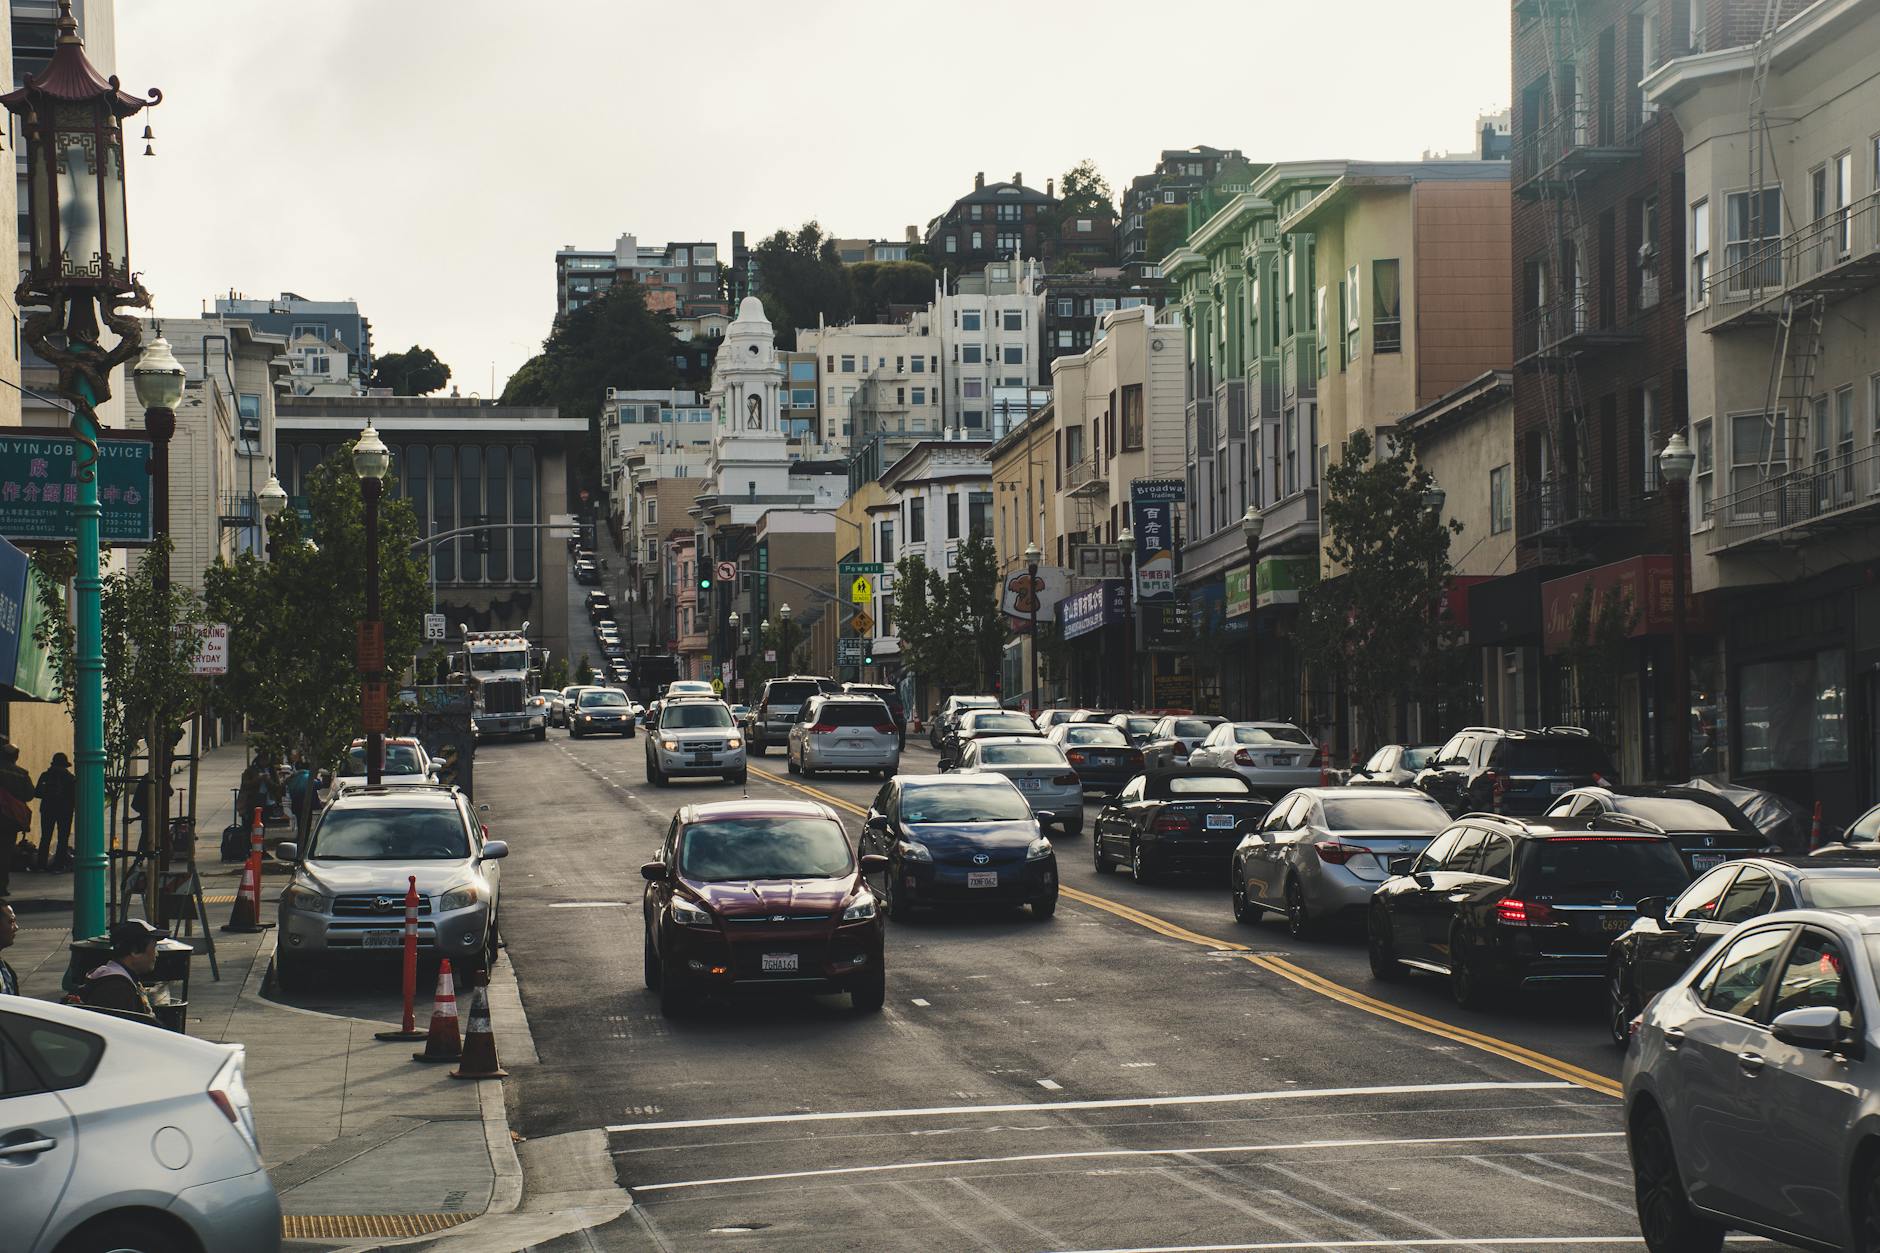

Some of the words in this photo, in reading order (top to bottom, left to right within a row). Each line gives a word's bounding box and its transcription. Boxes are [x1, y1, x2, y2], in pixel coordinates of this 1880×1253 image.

[13, 443, 38, 455] YIN
[43, 444, 73, 456] JOB
[98, 446, 143, 458] RVICE
[2, 480, 142, 505] 作介紹服中心
[1151, 492, 1176, 500] Trading
[1143, 507, 1161, 551] 百老匯
[429, 628, 444, 638] 35
[191, 654, 221, 663] ERYDAY
[1602, 919, 1632, 930] C692P
[763, 959, 797, 969] 7GHA161
